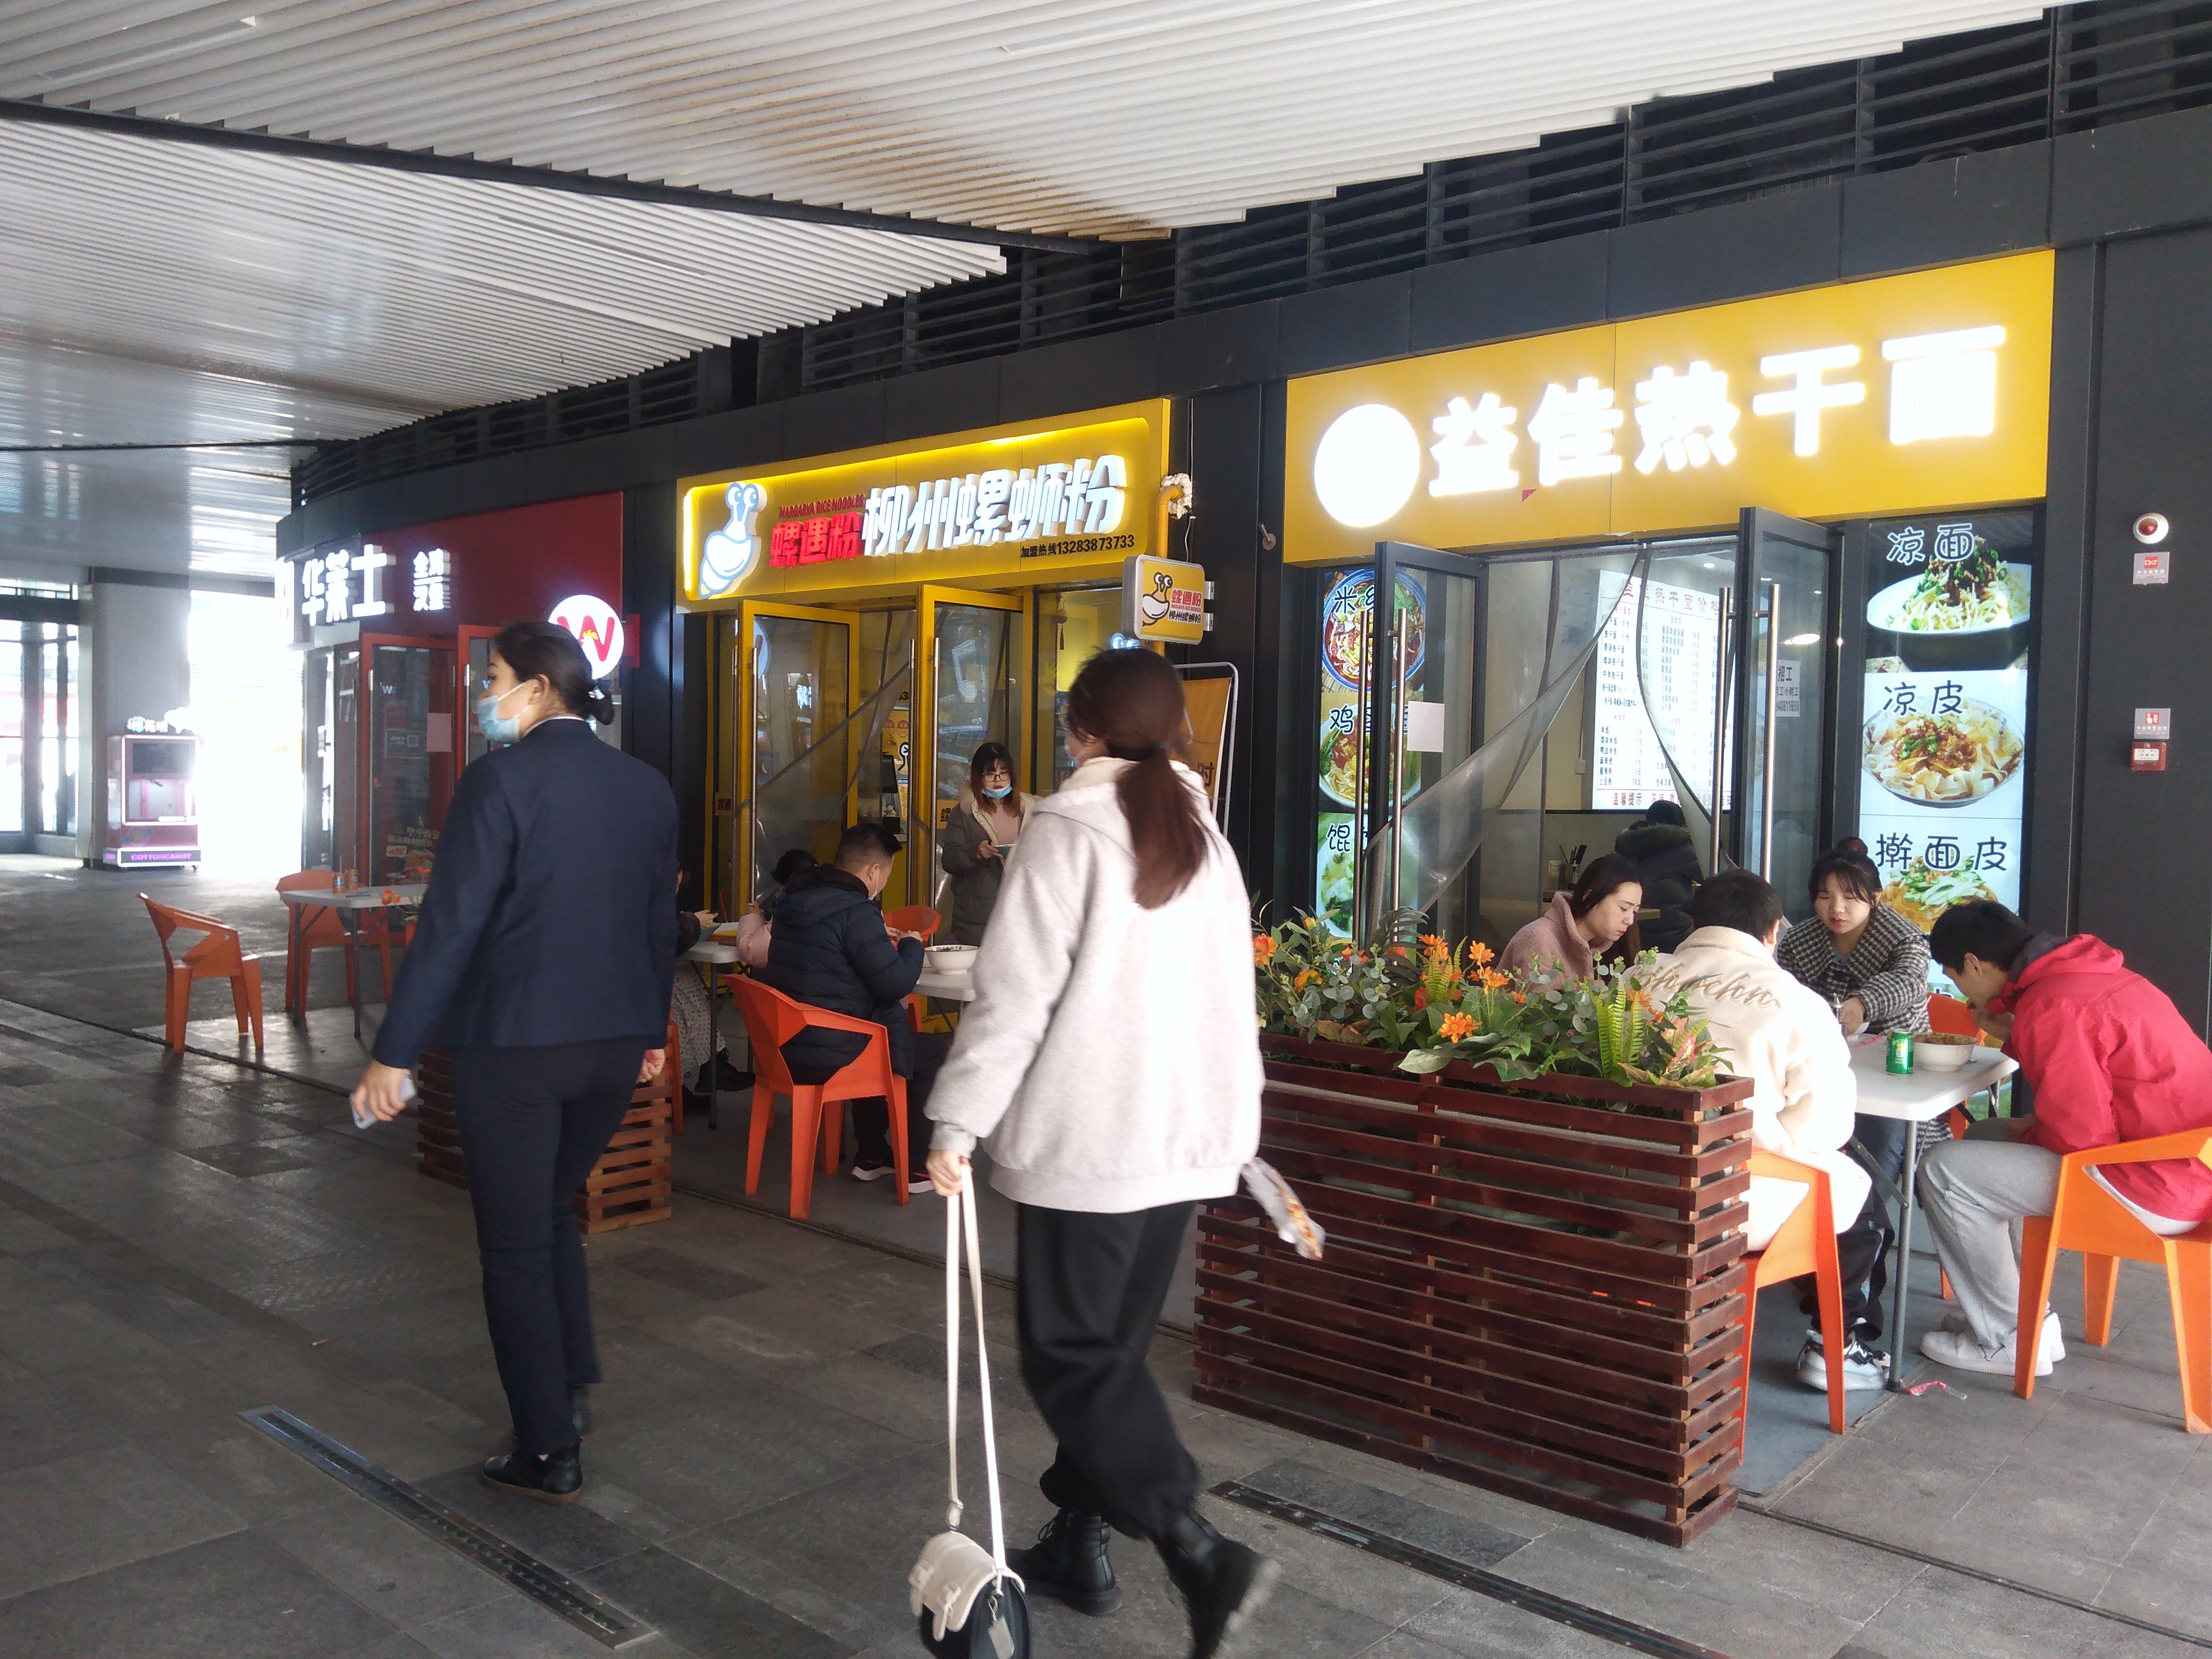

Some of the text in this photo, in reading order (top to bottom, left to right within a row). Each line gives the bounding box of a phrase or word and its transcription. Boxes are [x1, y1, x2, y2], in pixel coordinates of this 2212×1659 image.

[1429, 325, 2006, 497] 益佳热干面
[817, 499, 831, 514] RICE
[832, 494, 864, 511] NOODLES
[862, 455, 1127, 556] 柳州螺蛳粉
[1886, 522, 1974, 566] 凉面
[302, 544, 387, 626] 华莱士
[1778, 665, 1792, 682] 招工
[1882, 680, 1964, 715] 凉皮
[1876, 833, 2008, 871] 擀面皮
